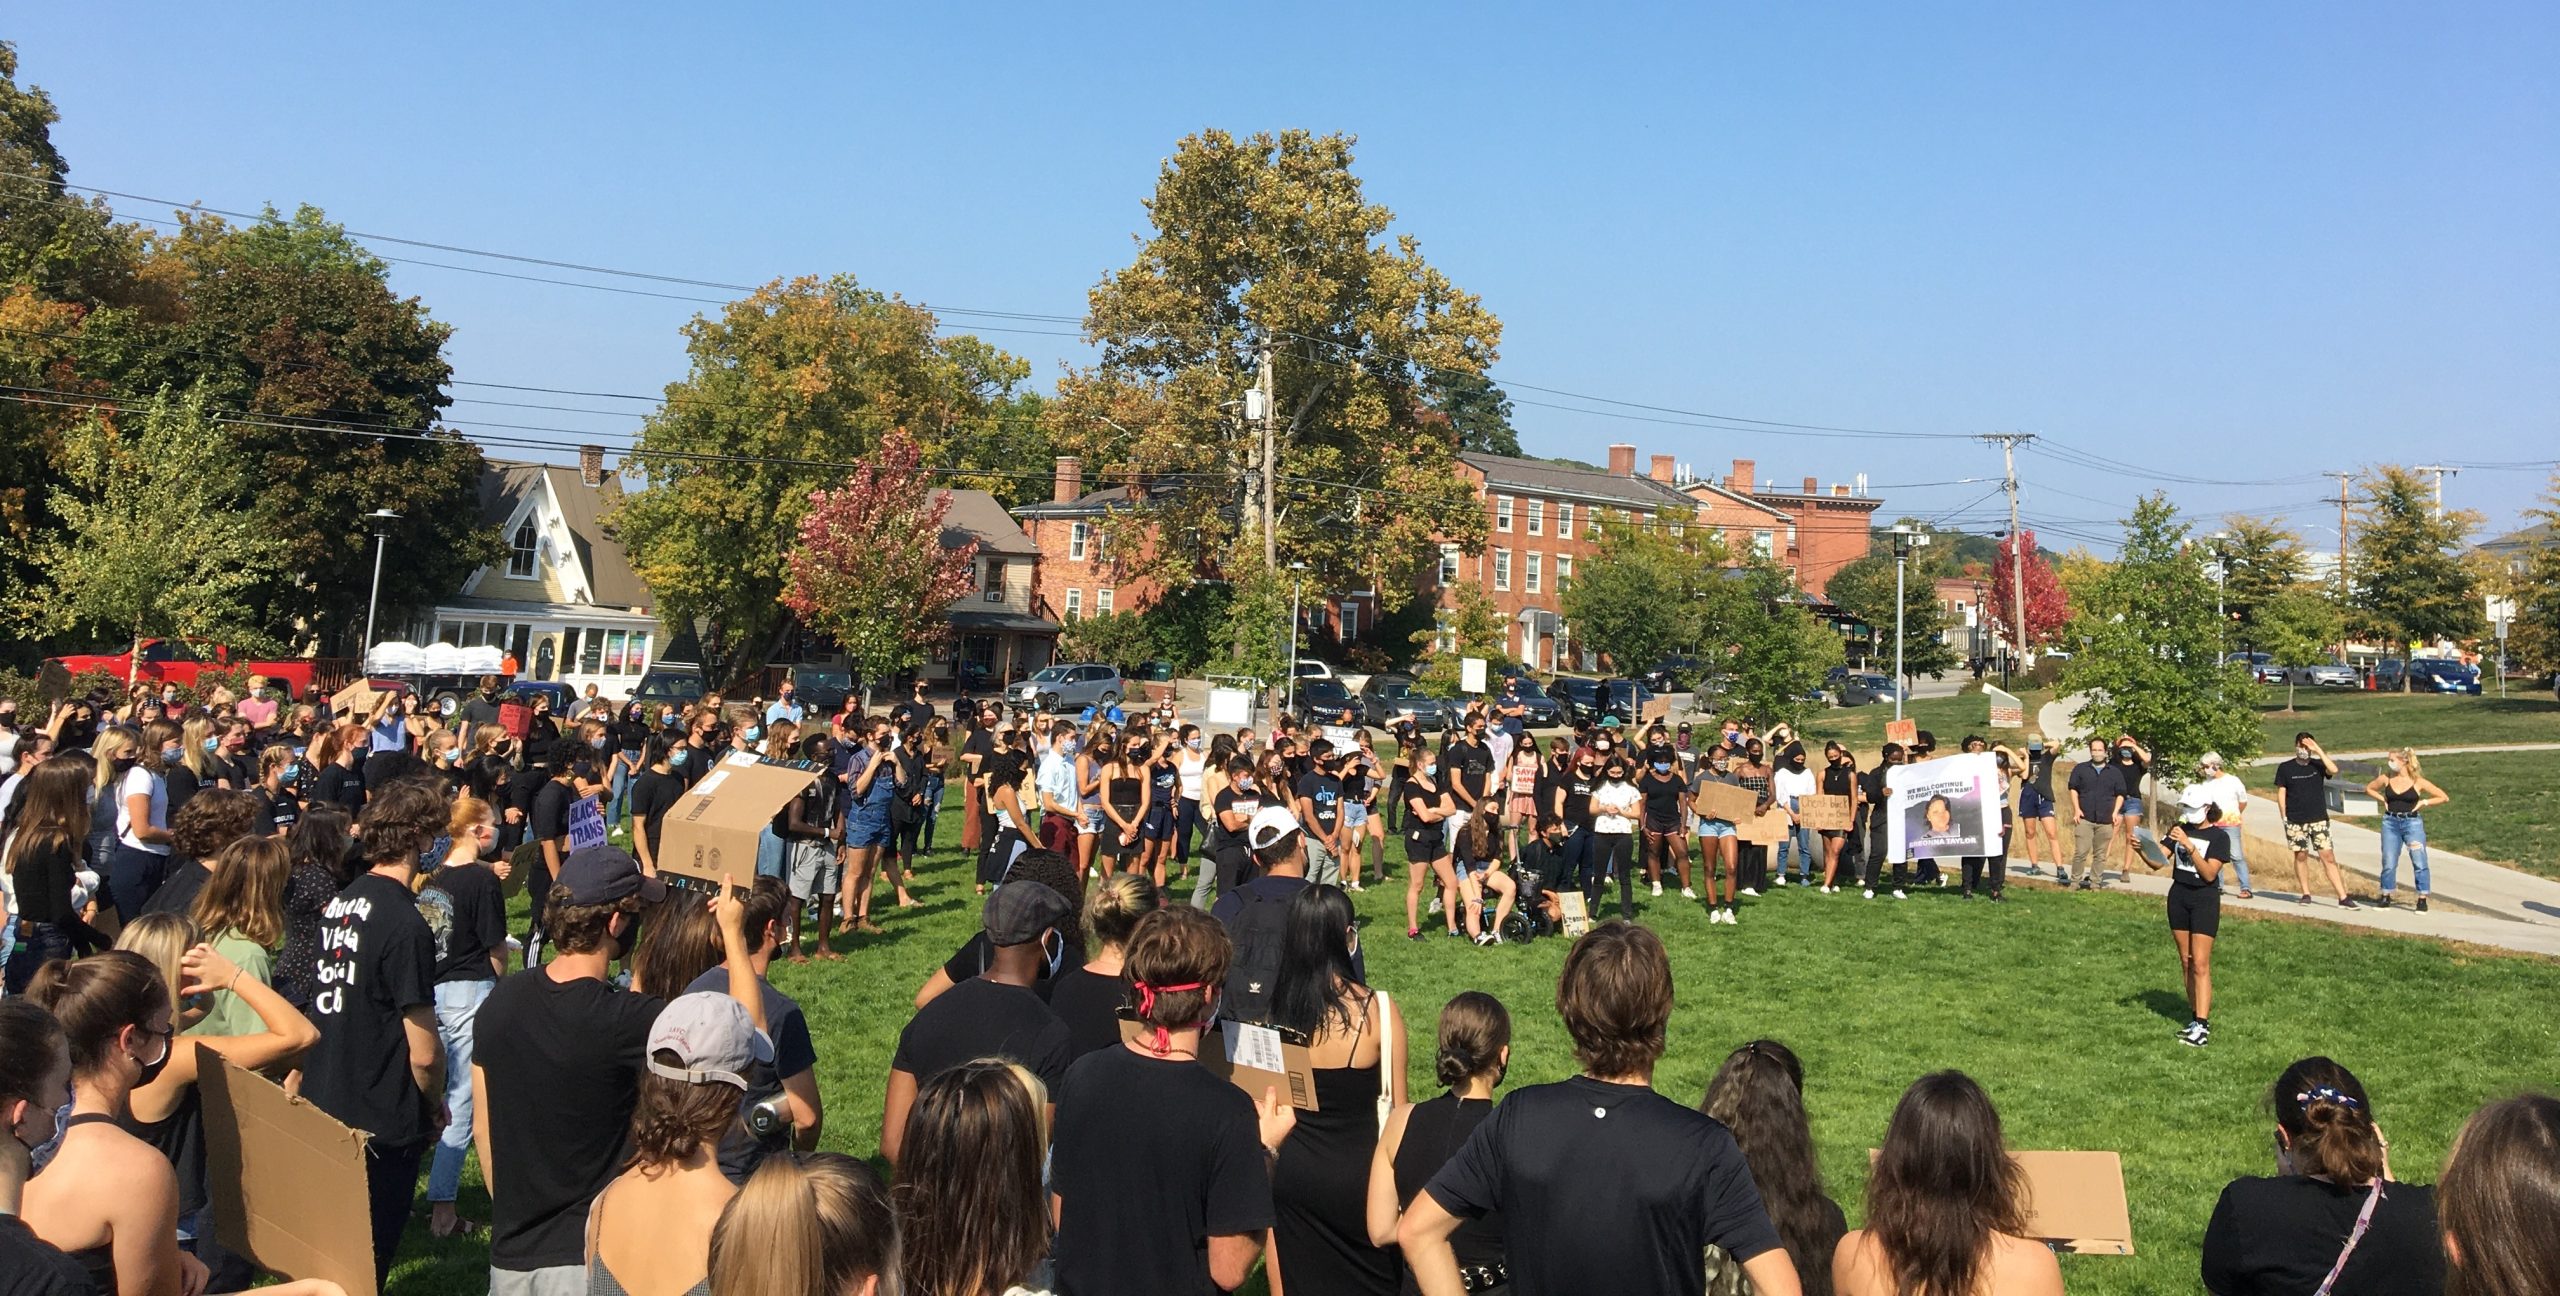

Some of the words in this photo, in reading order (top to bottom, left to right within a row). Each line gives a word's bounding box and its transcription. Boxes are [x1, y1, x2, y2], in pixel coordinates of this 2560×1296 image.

[1327, 727, 1353, 737] BLACK
[1887, 721, 1914, 735] FUCK
[1930, 781, 1963, 790] CONTINUE
[1915, 790, 1933, 798] FIGHT
[570, 799, 597, 825] BLACK
[570, 820, 604, 846] TRANS
[1909, 840, 1944, 848] BREONNA
[1945, 837, 1977, 845] TAYLOR
